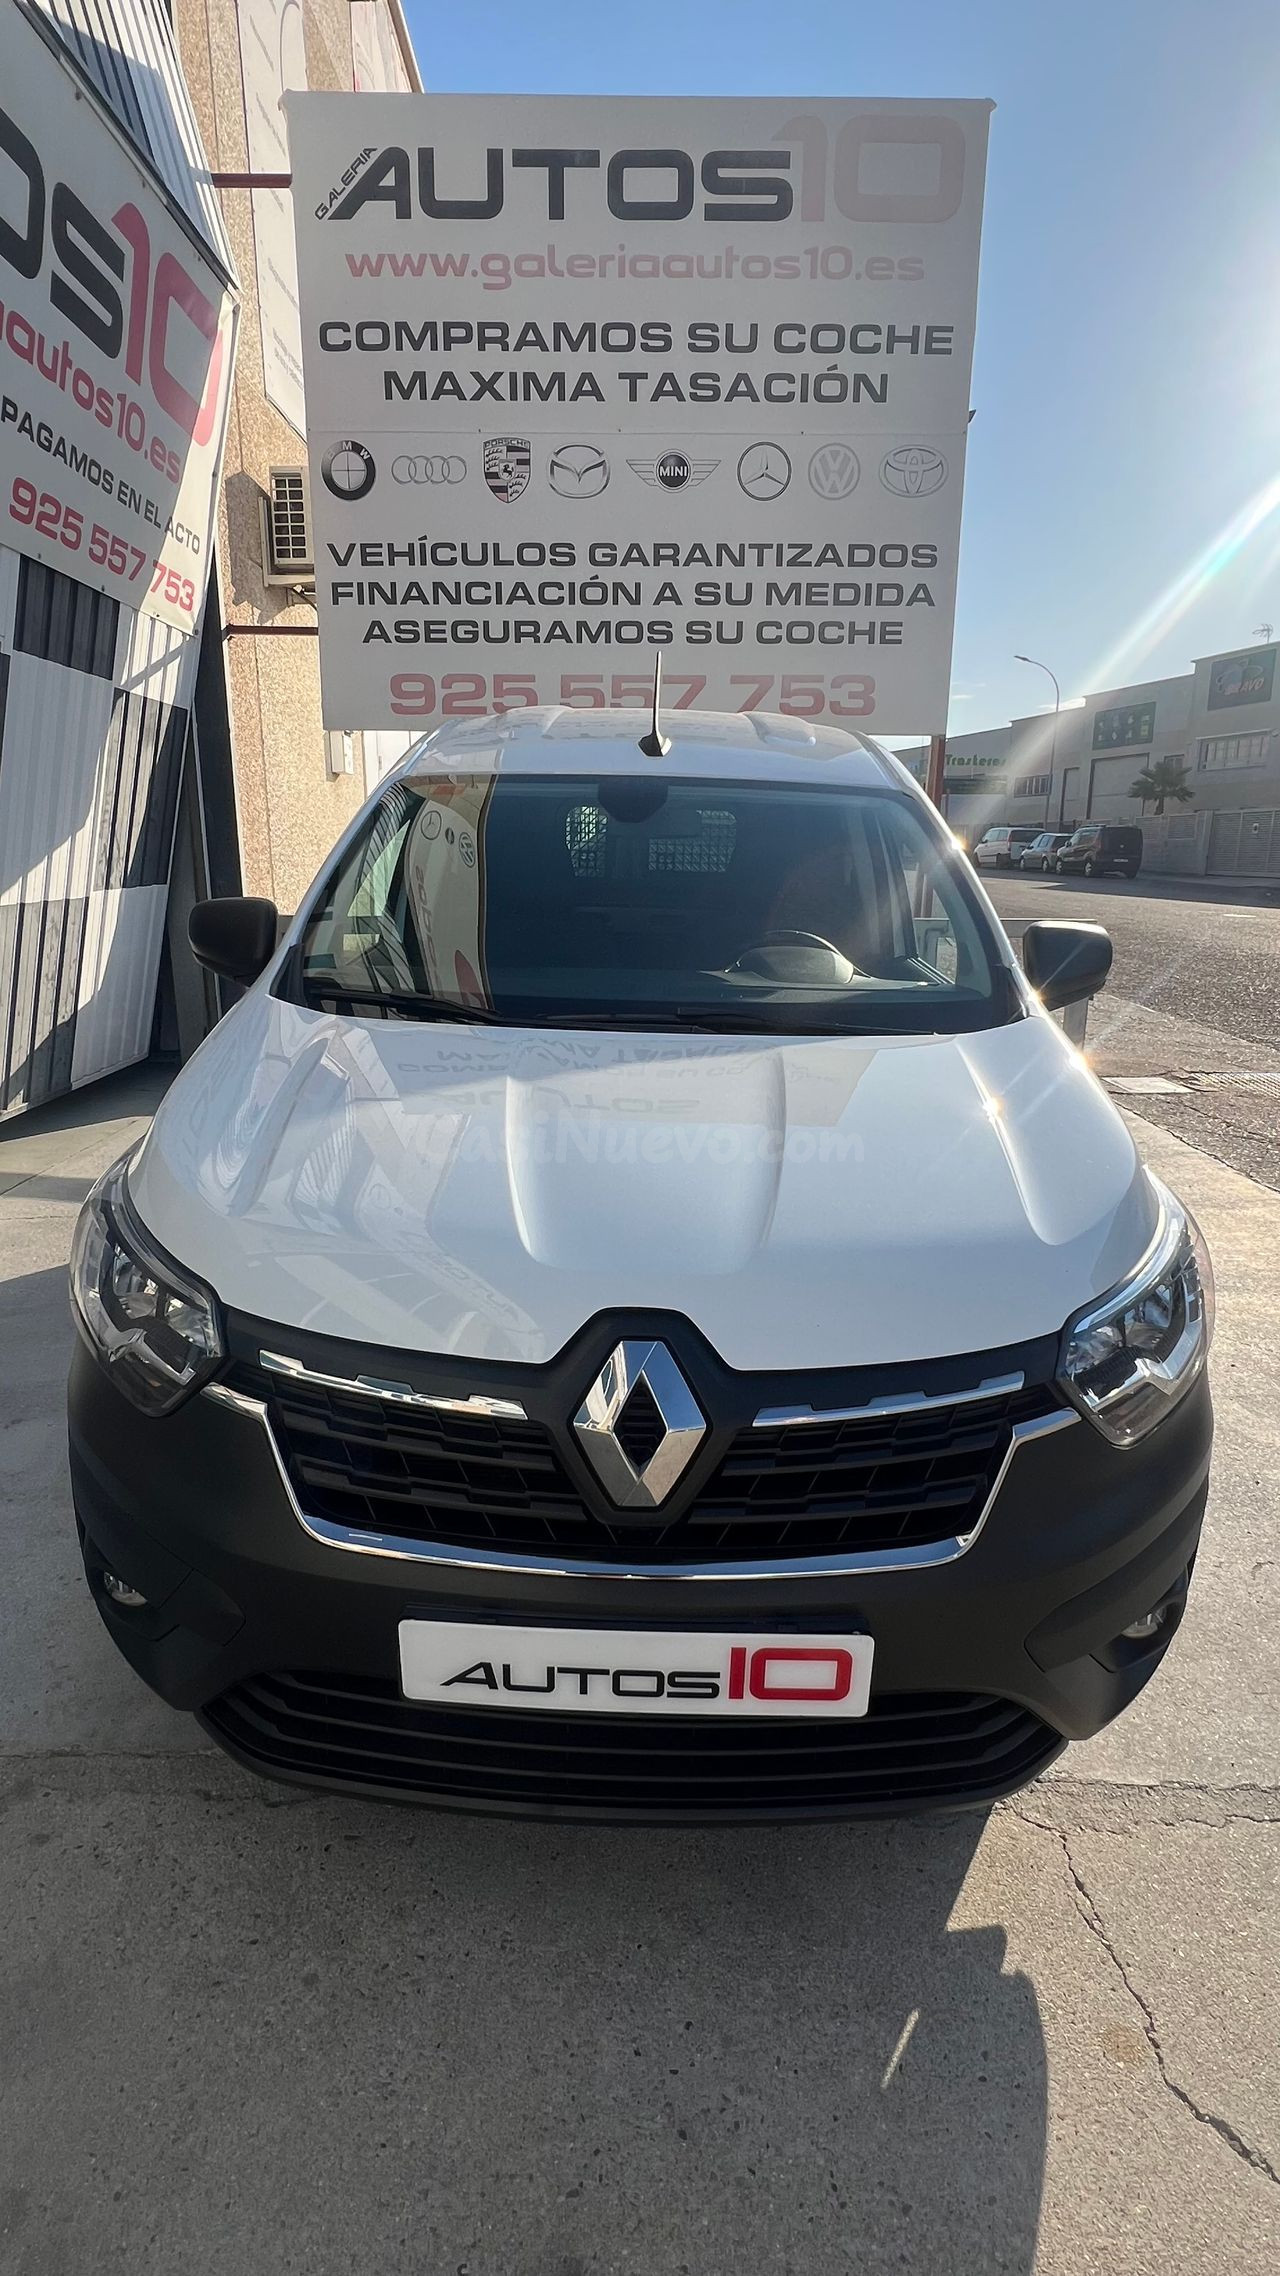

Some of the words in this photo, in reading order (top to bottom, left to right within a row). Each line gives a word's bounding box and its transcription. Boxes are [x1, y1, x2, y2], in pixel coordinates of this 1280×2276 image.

[314, 147, 378, 221] GALERIA
[345, 243, 924, 290] www.galeriaautos10.es
[318, 320, 673, 354] COMPRAMOS
[687, 322, 760, 355] SU
[773, 322, 954, 356] COCHE
[383, 369, 605, 402] MAXIMA
[617, 363, 889, 403] TASACIÓN
[1, 395, 114, 495] PAGAMOS
[117, 479, 142, 515] EN
[143, 498, 162, 529] EL
[164, 516, 200, 555] ACTO
[659, 466, 688, 478] MINI
[9, 477, 84, 551] 925
[88, 523, 147, 581] 557
[150, 559, 196, 612] 753
[326, 535, 577, 568] VEHÍCULOS
[588, 542, 938, 568] GARANTIZADOS
[330, 574, 643, 607] FINANCIACIÓN
[655, 581, 684, 607] A
[693, 582, 754, 607] SU
[765, 582, 937, 608] MEDIDA
[361, 619, 674, 645] ASEGURAMOS
[684, 620, 743, 645] SU
[755, 620, 904, 645] COCHE
[389, 673, 538, 715] 925
[560, 674, 707, 710] 557
[730, 674, 877, 716] 753
